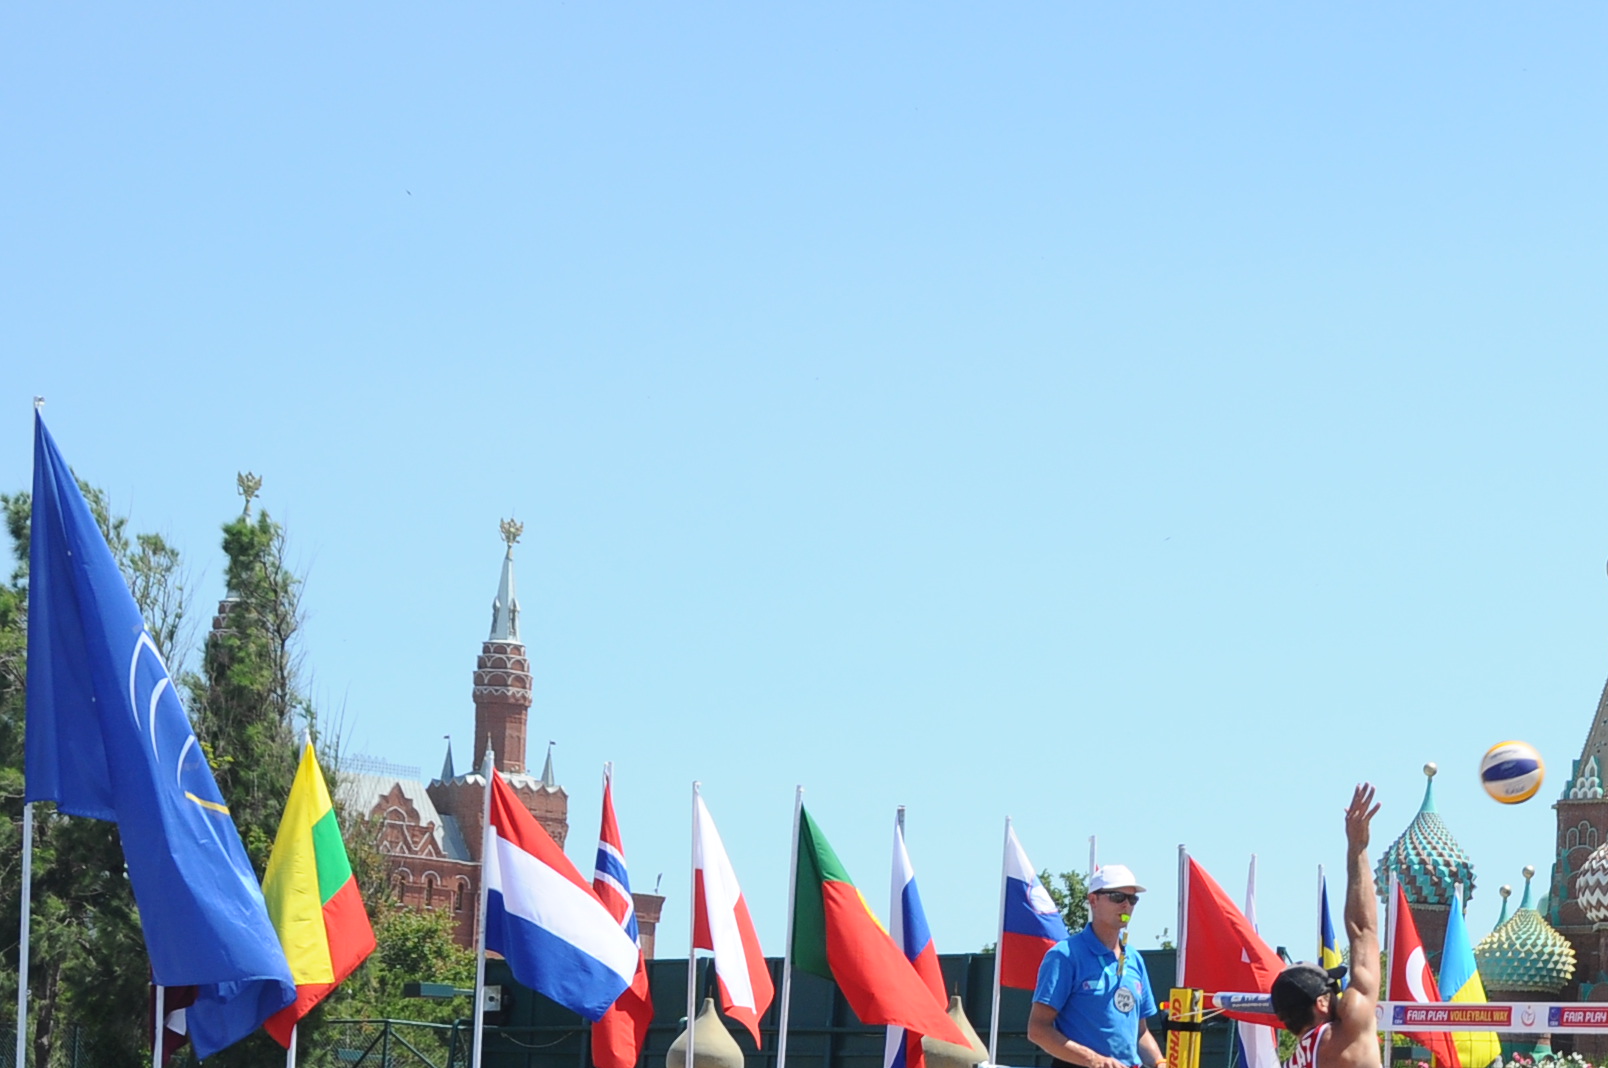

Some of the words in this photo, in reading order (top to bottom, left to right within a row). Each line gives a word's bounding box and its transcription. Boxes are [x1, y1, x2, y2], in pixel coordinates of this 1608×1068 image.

[1407, 1010, 1426, 1021] FAIR
[1427, 1010, 1448, 1021] PLAY
[1450, 1010, 1491, 1022] VOLLEYBALL
[1493, 1011, 1509, 1022] WAY
[1563, 1012, 1584, 1022] FAIR
[1585, 1012, 1607, 1023] PLAY
